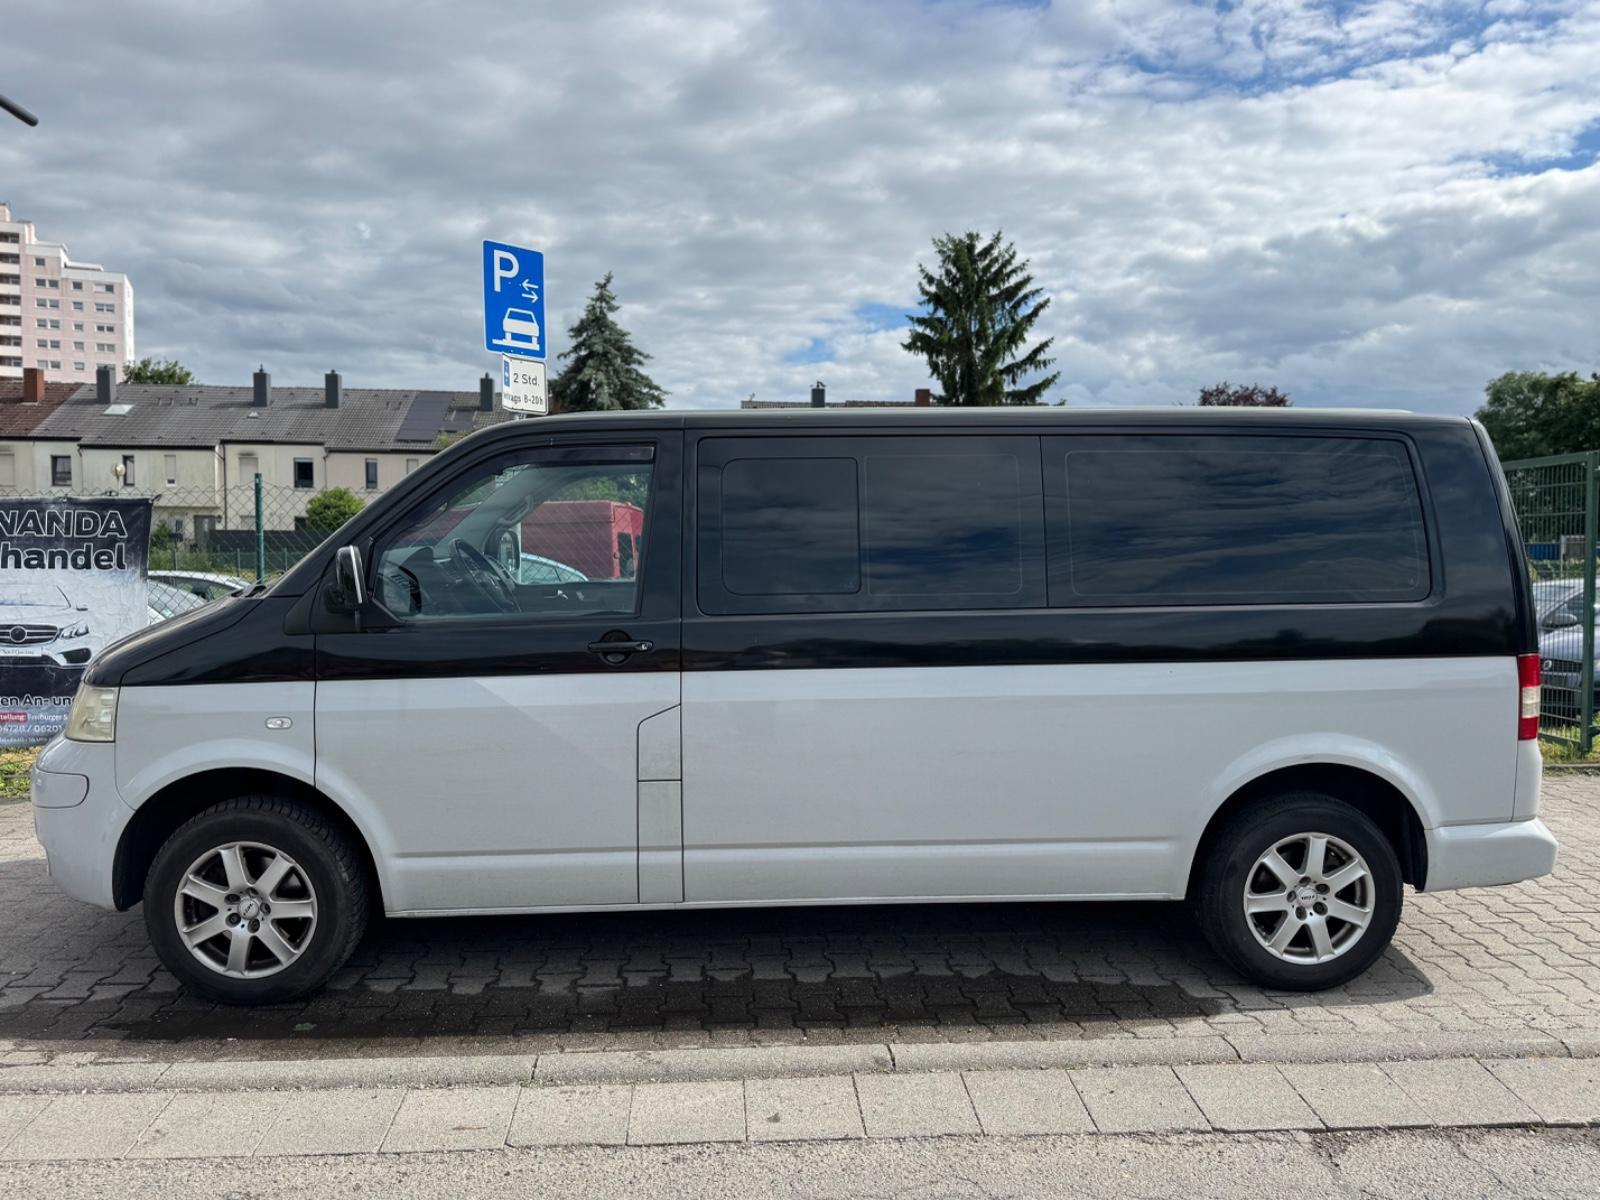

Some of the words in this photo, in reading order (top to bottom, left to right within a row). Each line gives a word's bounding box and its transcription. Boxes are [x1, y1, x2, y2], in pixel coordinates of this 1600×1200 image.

[493, 249, 520, 292] P
[513, 372, 519, 384] 2
[521, 373, 540, 387] Std.
[0, 541, 127, 571] handel
